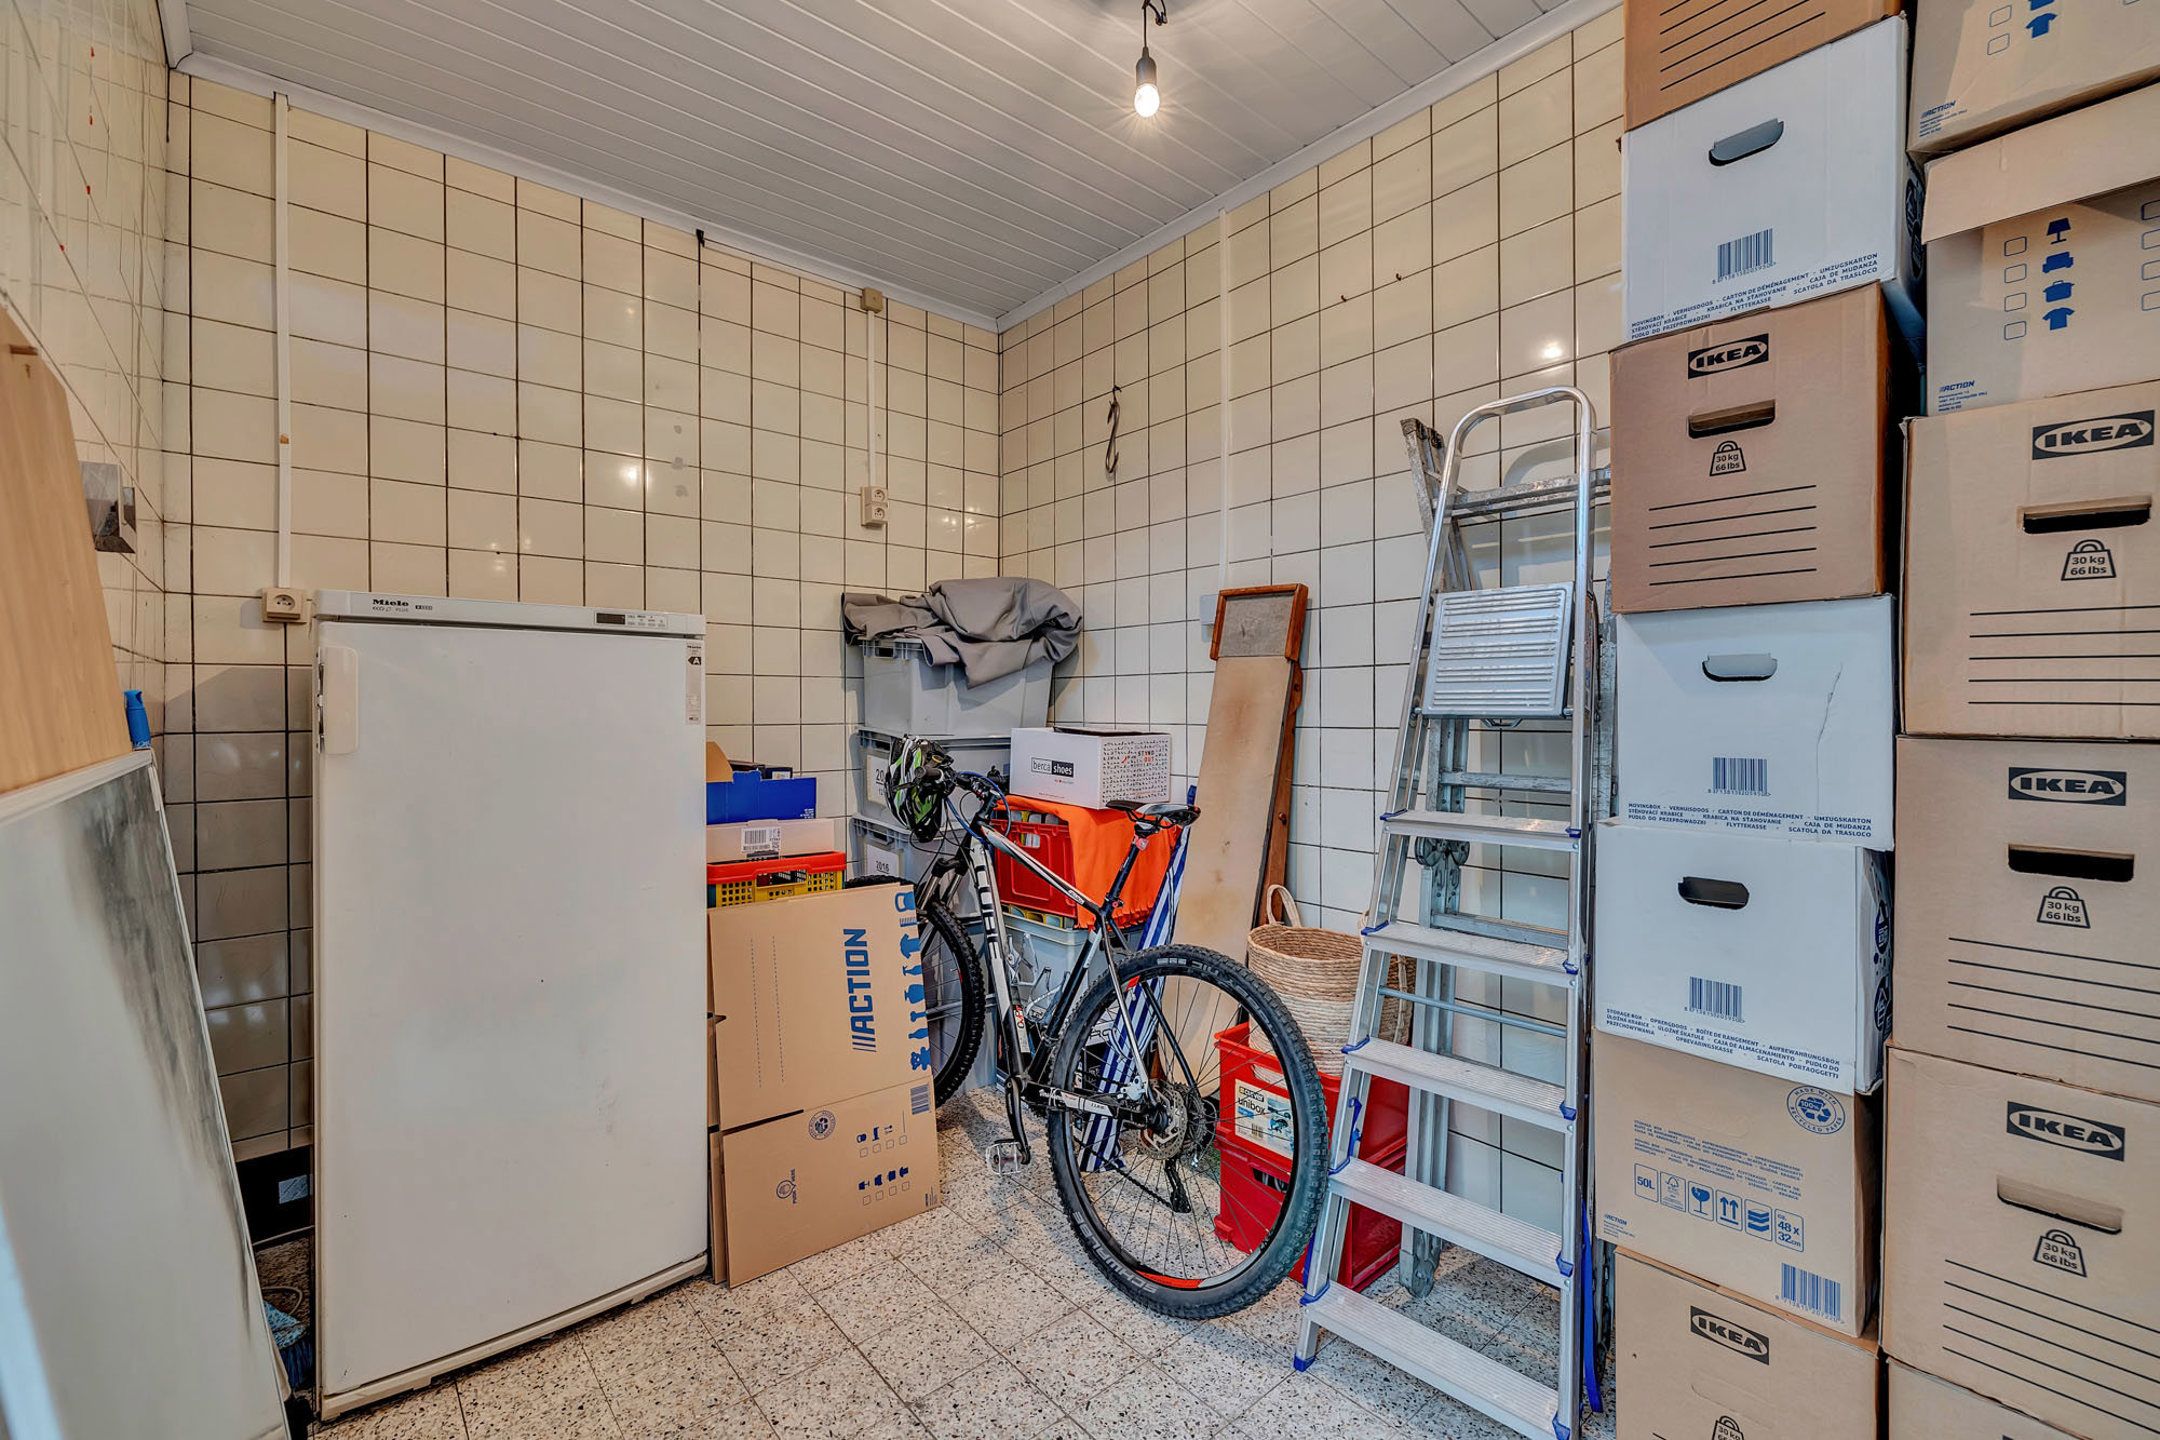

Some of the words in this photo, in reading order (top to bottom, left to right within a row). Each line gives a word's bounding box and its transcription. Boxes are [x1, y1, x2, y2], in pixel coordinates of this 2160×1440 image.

[1809, 274, 1826, 283] CAJA
[1841, 259, 1878, 274] MUDANZA
[1792, 281, 1824, 295] SCATOLA
[1839, 266, 1878, 281] TRASLOCO
[1631, 313, 1665, 327] MOVINGBOX
[1722, 289, 1747, 301] CARTON
[1819, 252, 1878, 273] UMZUGSKARTON
[1696, 343, 1762, 369] IKEA
[1939, 379, 1975, 392] ACTION
[2045, 423, 2143, 448] IKEA
[1716, 455, 1727, 463] 30
[1728, 453, 1739, 461] kg
[1727, 461, 1740, 469] lbs
[2072, 556, 2087, 565] 30
[2089, 555, 2106, 565] kg
[2070, 567, 2086, 576] 66
[2088, 565, 2107, 575] lbs
[372, 598, 409, 606] Miele
[693, 657, 700, 665] A
[1053, 763, 1072, 775] shoes
[2020, 777, 2116, 794] IKEA
[1668, 805, 1709, 813] VERHUISDOOS
[1813, 815, 1872, 824] UMZUGSKARTON
[1726, 822, 1767, 830] FLYTTEKASSE
[1835, 823, 1872, 831] MUDANZA
[876, 860, 889, 873] 2016
[2047, 901, 2062, 911] 30
[2064, 903, 2080, 914] kg
[2046, 911, 2061, 920] 66
[2063, 912, 2081, 923] lbs
[843, 929, 876, 1037] ACTION
[1721, 1034, 1759, 1046] RANGEMENT
[1713, 1038, 1729, 1046] CAJA
[1737, 1044, 1795, 1061] ALMACENAMIENTO
[1756, 1055, 1785, 1066] SCATOLA
[2019, 1113, 2114, 1148] IKEA
[1637, 1176, 1655, 1190] 50L
[1778, 1221, 1791, 1232] 48
[1778, 1231, 1801, 1247] 32cm
[1072, 1211, 1158, 1294] SCHWALBE
[2043, 1242, 2059, 1253] 30
[2060, 1246, 2076, 1260] kg
[2042, 1252, 2058, 1263] 66
[2059, 1255, 2078, 1270] lbs
[1698, 1316, 1762, 1354] IKEA
[1718, 1425, 1729, 1436] 30
